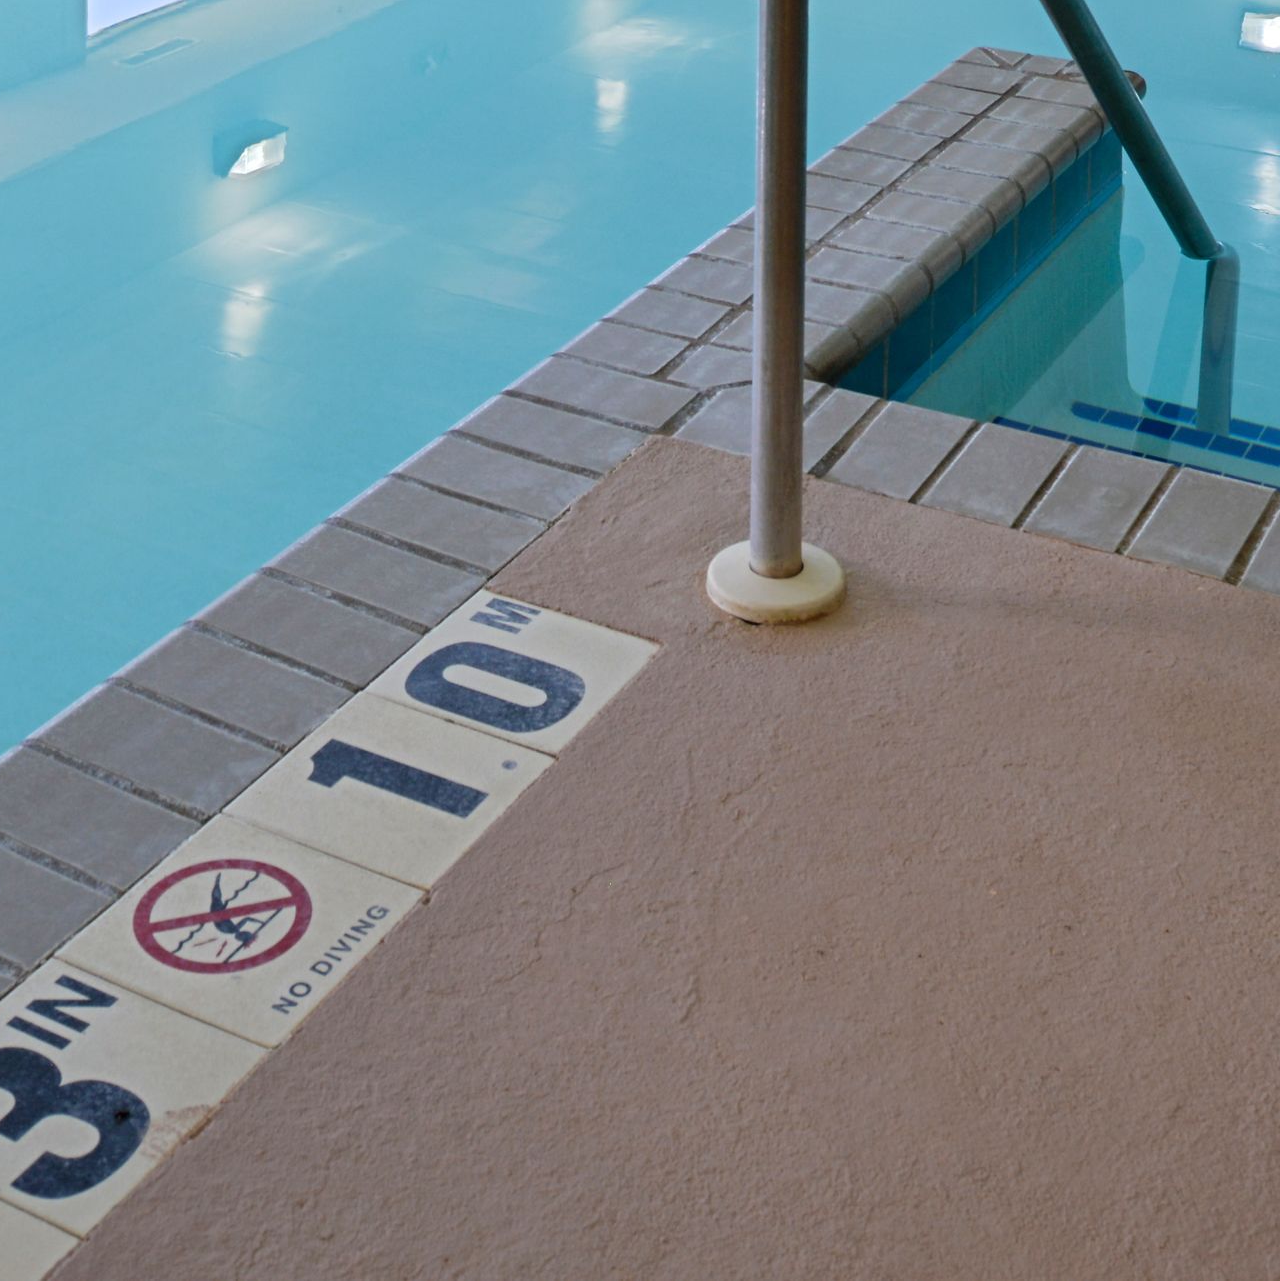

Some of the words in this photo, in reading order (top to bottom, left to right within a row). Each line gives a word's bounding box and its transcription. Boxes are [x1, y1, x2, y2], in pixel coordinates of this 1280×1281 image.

[469, 597, 542, 635] M
[272, 981, 312, 1015] NO
[309, 905, 390, 977] DIVING
[5, 974, 119, 1051] IN
